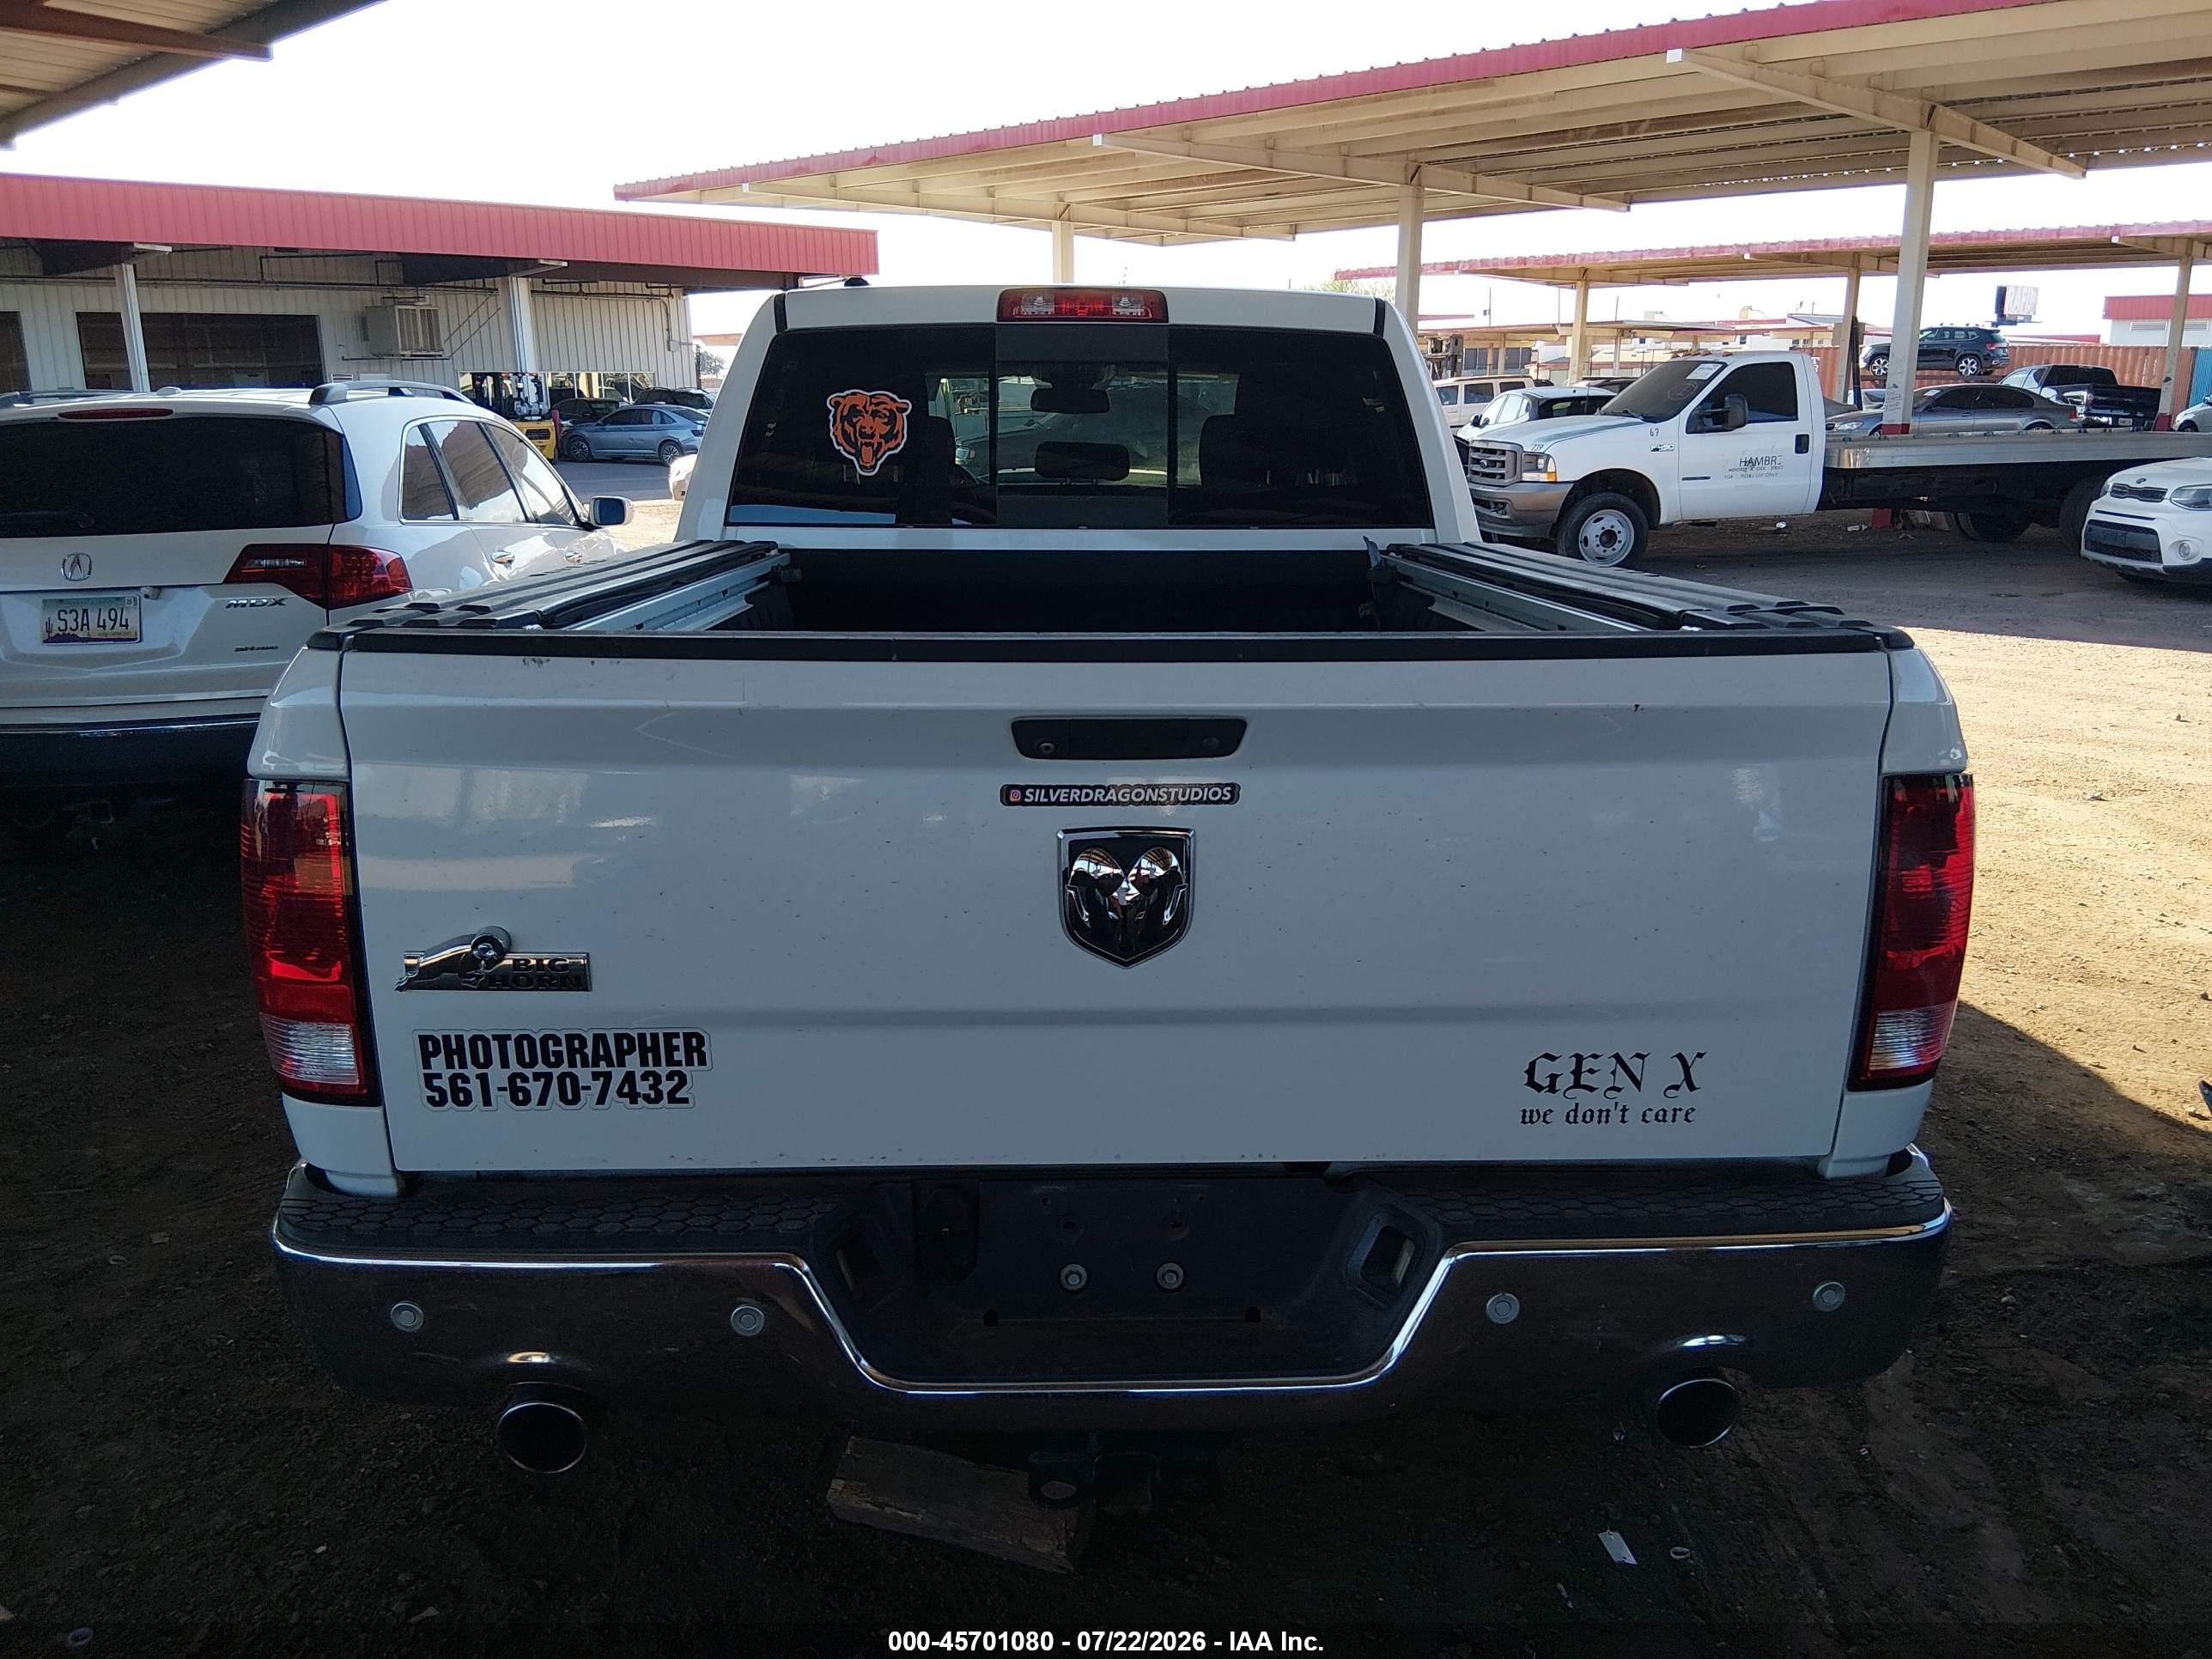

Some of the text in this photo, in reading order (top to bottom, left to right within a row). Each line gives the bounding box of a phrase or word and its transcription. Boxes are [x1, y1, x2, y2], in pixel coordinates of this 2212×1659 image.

[226, 598, 288, 609] MDX
[58, 607, 129, 632] S3A 494
[1024, 785, 1232, 804] SILVERDRAGONSTUDIOS
[513, 957, 570, 973] BIG
[418, 1030, 708, 1070] PHOTOGRAPHER
[1523, 1052, 1707, 1099] GEN X
[422, 1070, 690, 1108] 561-670-7432
[1521, 1102, 1696, 1125] we don't care
